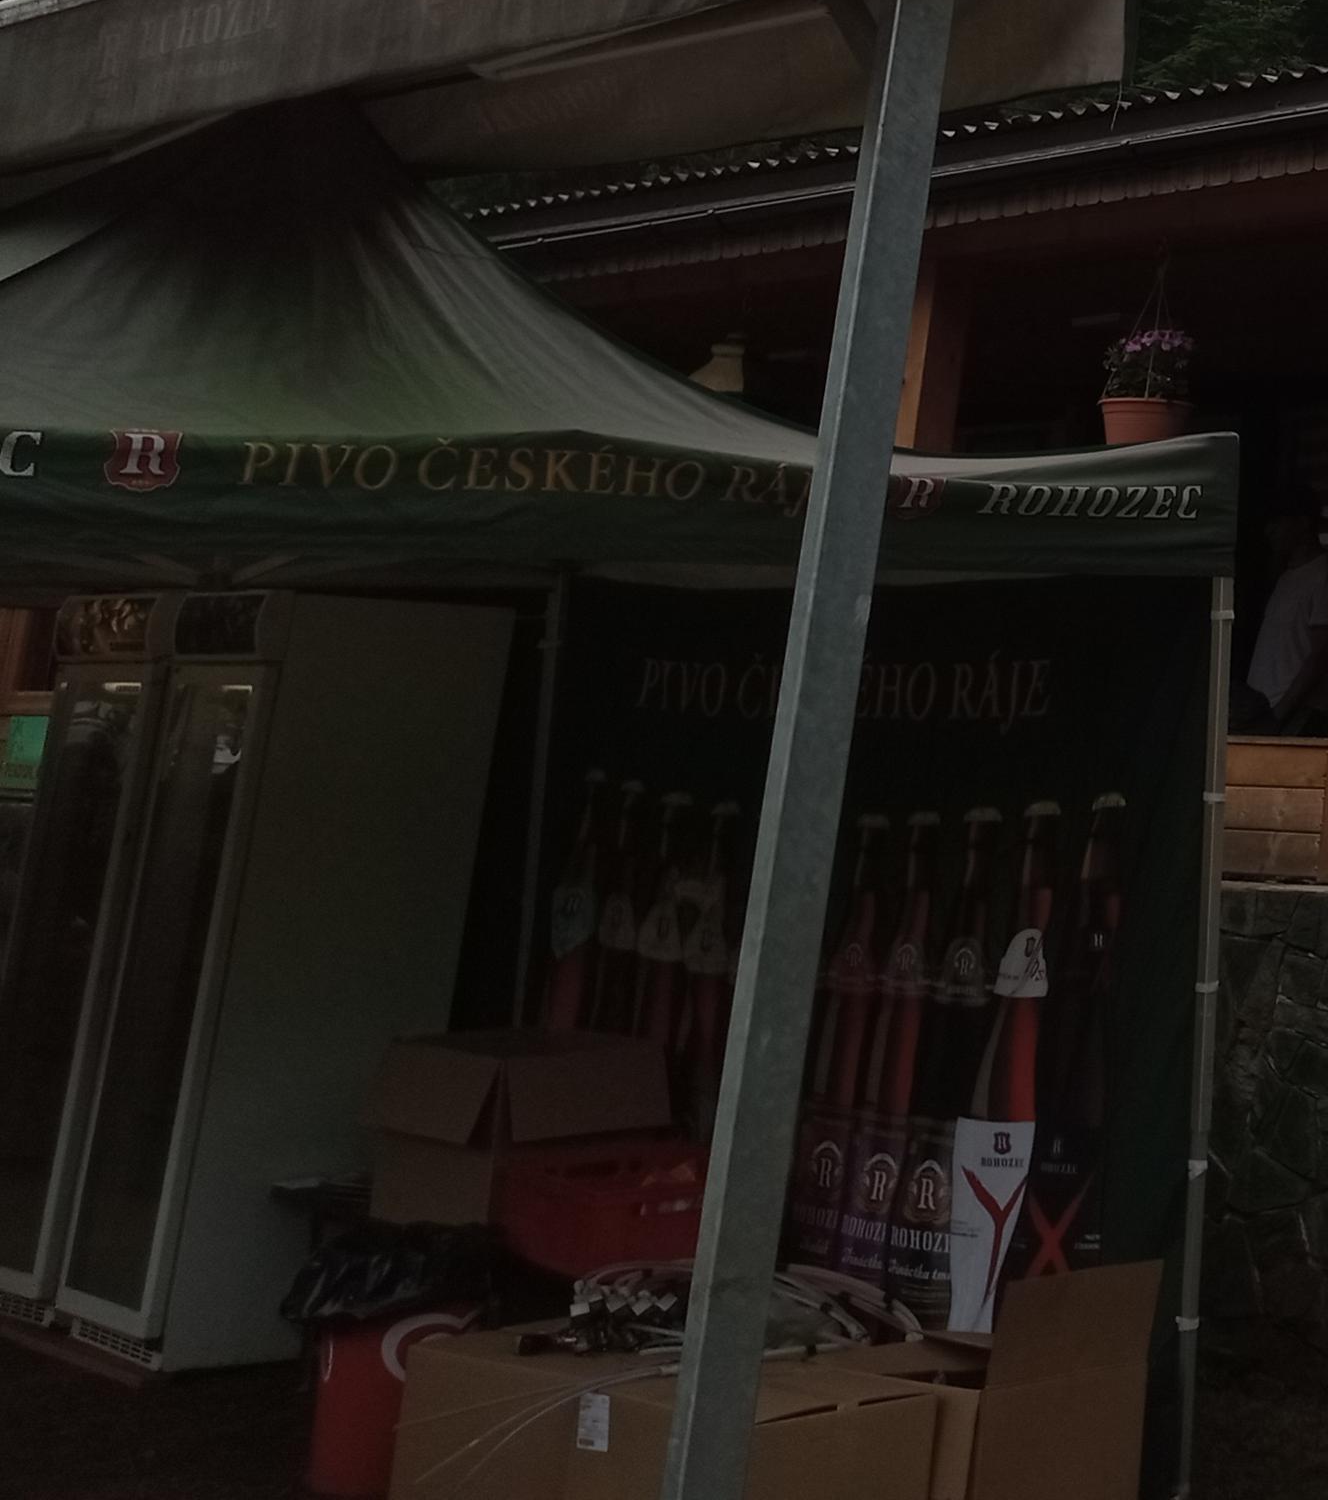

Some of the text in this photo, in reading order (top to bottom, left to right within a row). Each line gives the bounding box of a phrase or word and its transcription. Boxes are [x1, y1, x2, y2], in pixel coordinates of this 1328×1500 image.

[119, 433, 166, 476] R
[238, 436, 812, 518] PIVO ČESKÉHO RÁJ
[896, 477, 935, 509] R
[978, 483, 1203, 521] ROHOZEC
[636, 657, 728, 718] PIVO
[948, 649, 1051, 735] RÁJE
[870, 1170, 887, 1201] R
[917, 1178, 936, 1211] R
